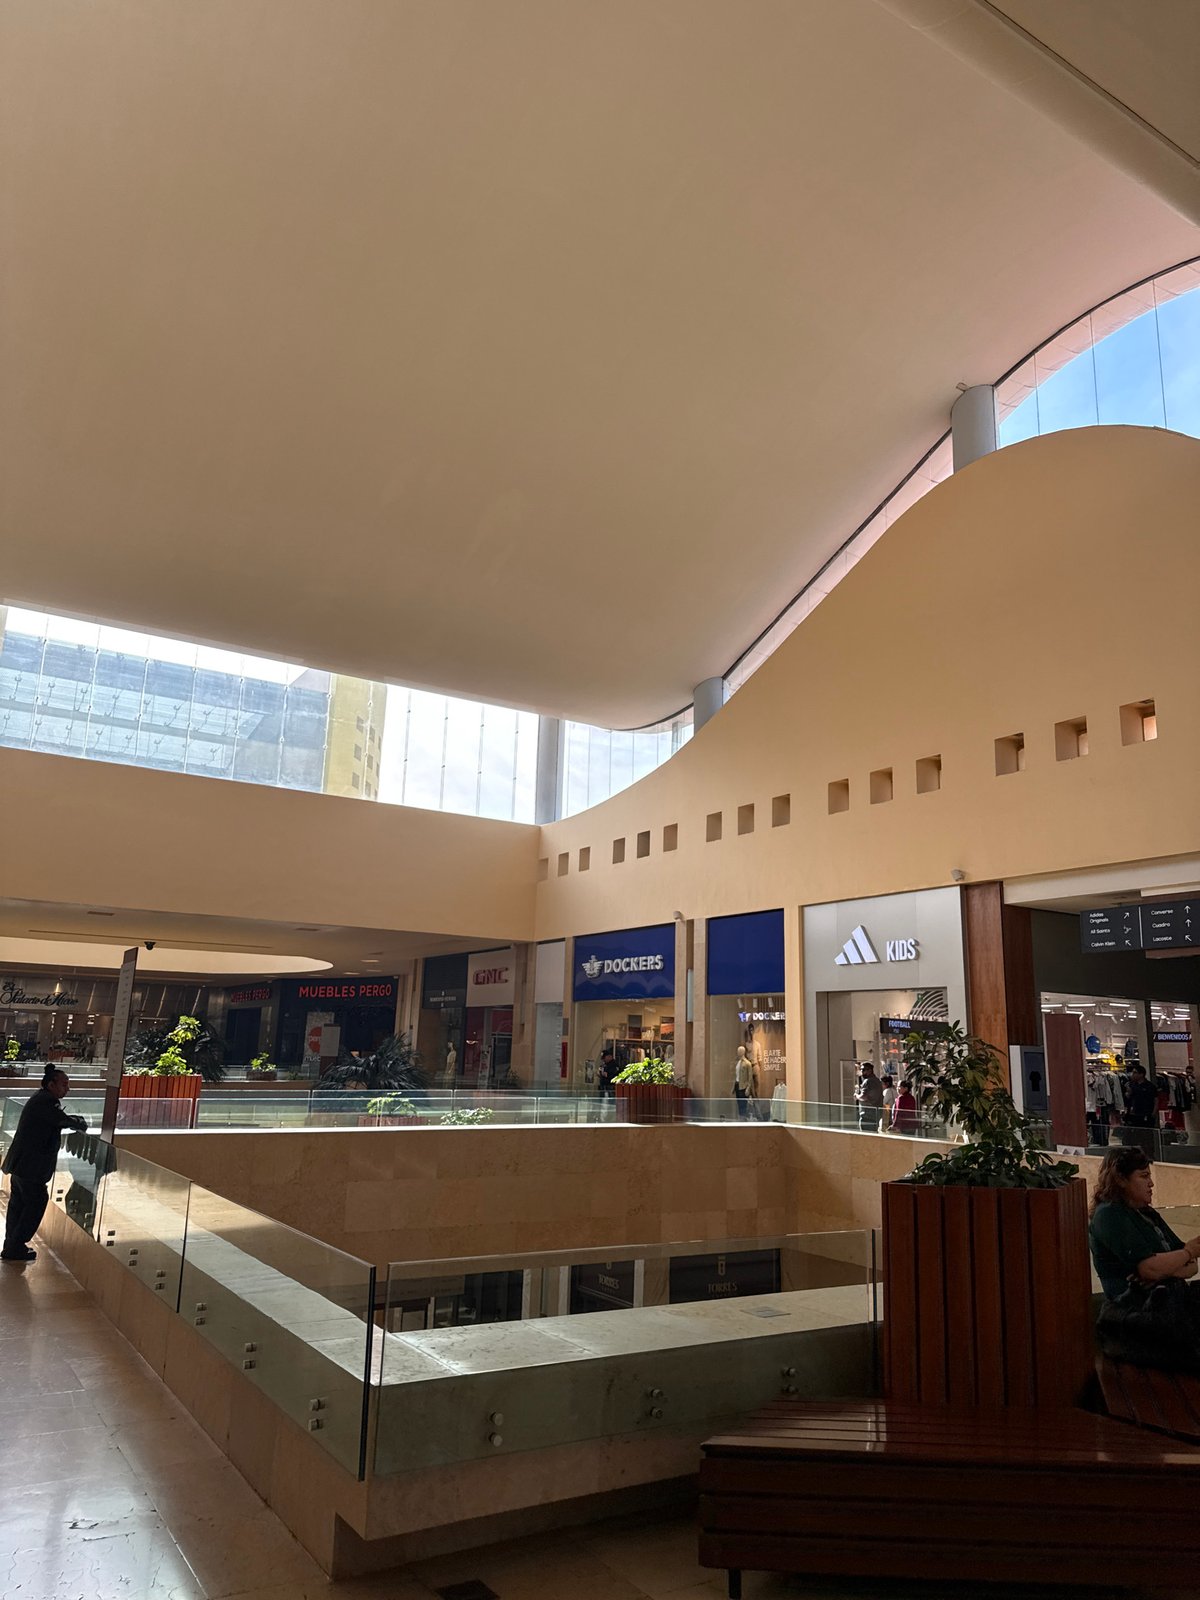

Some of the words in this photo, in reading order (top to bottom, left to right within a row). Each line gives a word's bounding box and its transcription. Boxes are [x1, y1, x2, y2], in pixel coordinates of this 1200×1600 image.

[886, 938, 918, 962] KIDS
[604, 955, 664, 974] DOCKERS
[473, 967, 509, 986] GNC
[298, 985, 356, 999] MUEBLES
[358, 983, 393, 998] PERGO
[888, 1019, 912, 1029] FOOTBALL
[1157, 1033, 1189, 1041] BIENVENIDOS
